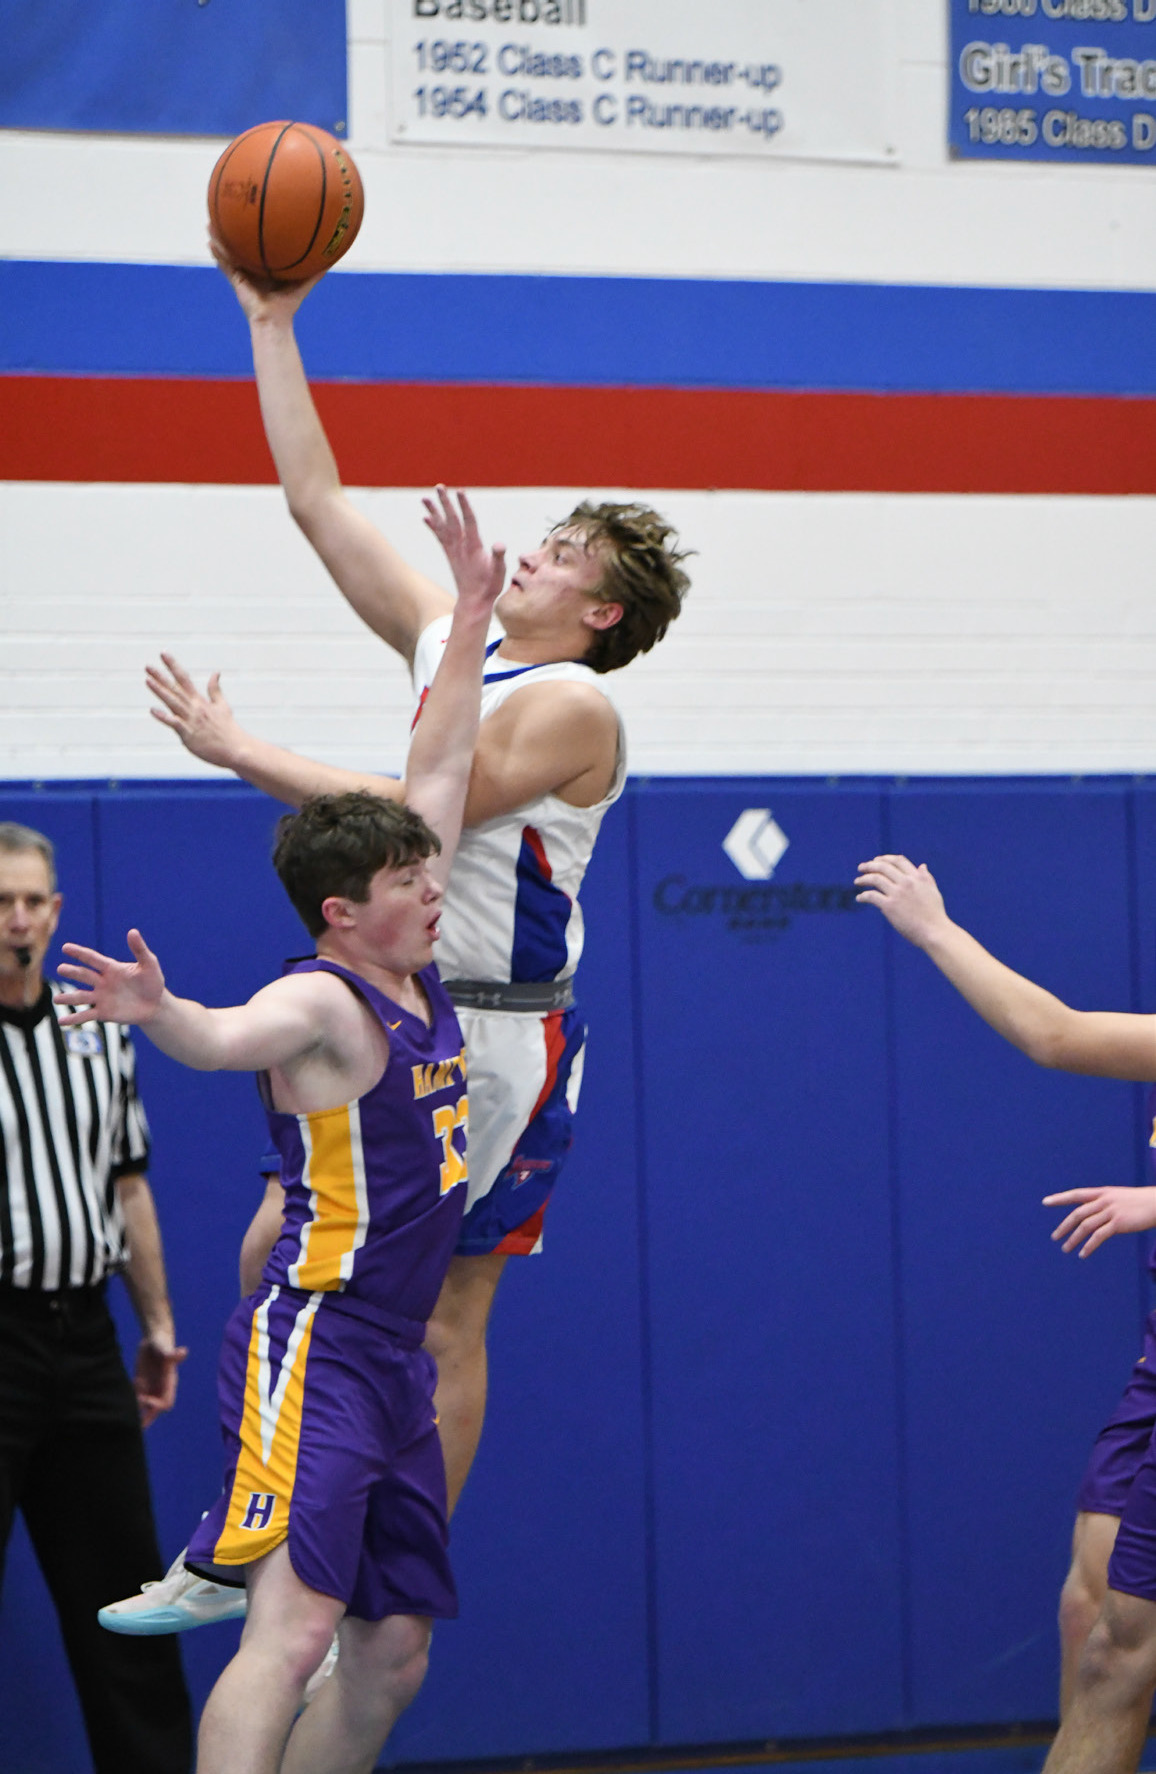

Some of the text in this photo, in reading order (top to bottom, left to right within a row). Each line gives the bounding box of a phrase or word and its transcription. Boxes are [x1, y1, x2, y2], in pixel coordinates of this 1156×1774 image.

[413, 39, 783, 94] 1952 Class C Runner-up
[959, 41, 1072, 97] Girl's
[413, 85, 784, 140] 1954 Class C Runner-up
[1042, 109, 1127, 148] Class
[1132, 113, 1156, 150] D
[239, 1492, 277, 1531] H
